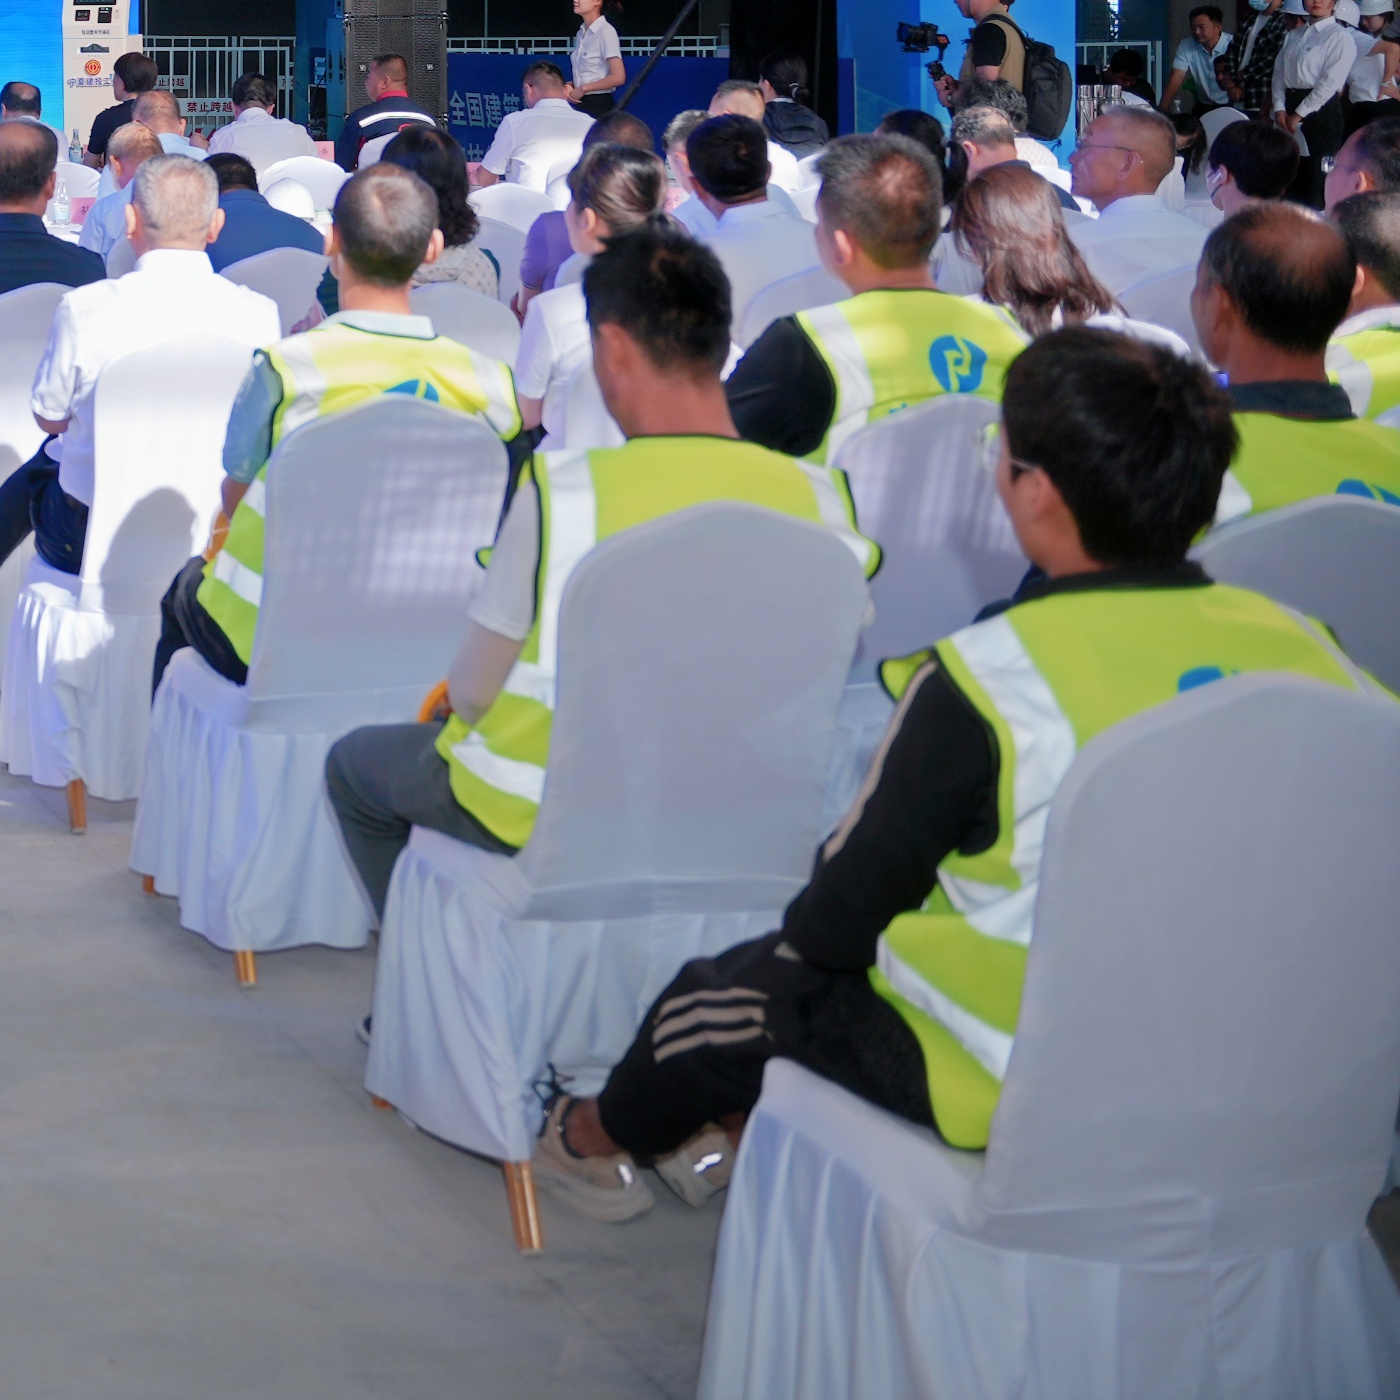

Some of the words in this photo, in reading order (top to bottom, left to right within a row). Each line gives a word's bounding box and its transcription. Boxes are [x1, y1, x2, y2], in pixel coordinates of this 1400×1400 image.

[67, 76, 114, 88] 宁夏建投工
[187, 101, 233, 113] 禁止跨越
